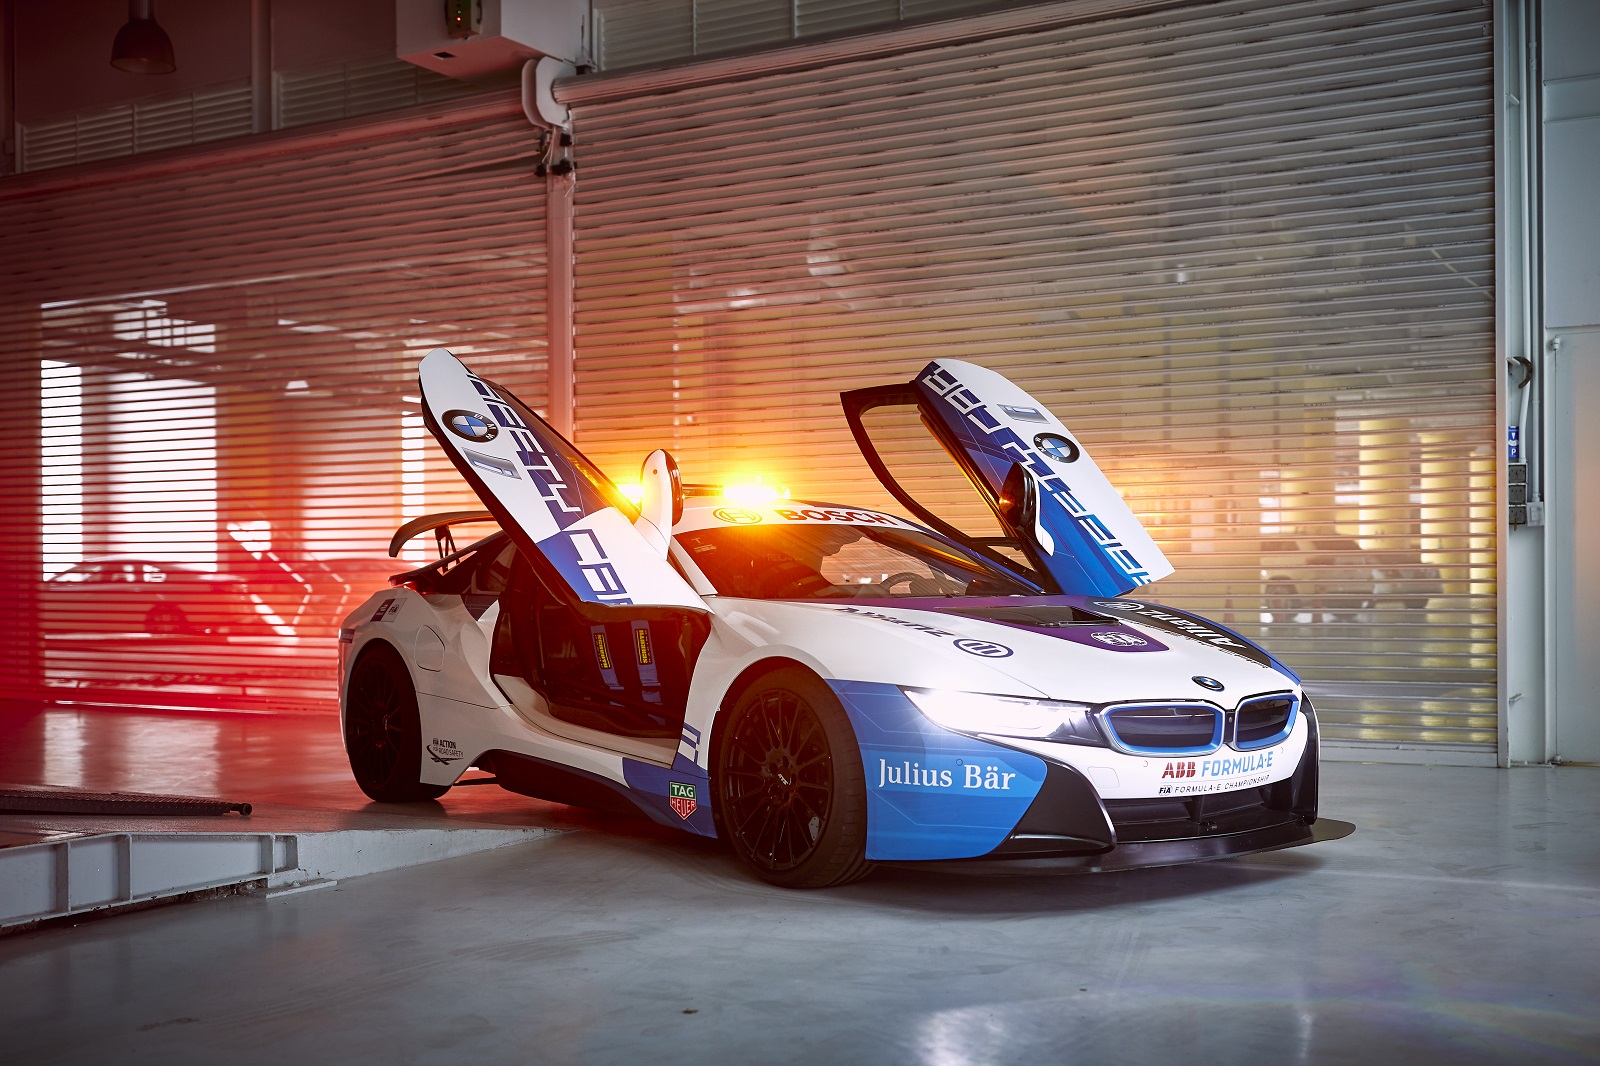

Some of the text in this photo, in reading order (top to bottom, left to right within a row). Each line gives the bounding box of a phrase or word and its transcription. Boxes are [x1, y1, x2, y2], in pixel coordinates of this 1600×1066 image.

[774, 509, 898, 526] BOSCH
[1136, 610, 1247, 649] Allianz
[440, 740, 457, 750] ACTION
[449, 749, 464, 758] SAFETY
[879, 758, 1016, 790] Julius Bär
[1161, 761, 1196, 779] ABB
[1224, 774, 1270, 790] CHAMPIONSHIP
[672, 784, 694, 798] TAG
[671, 798, 696, 817] HEUER
